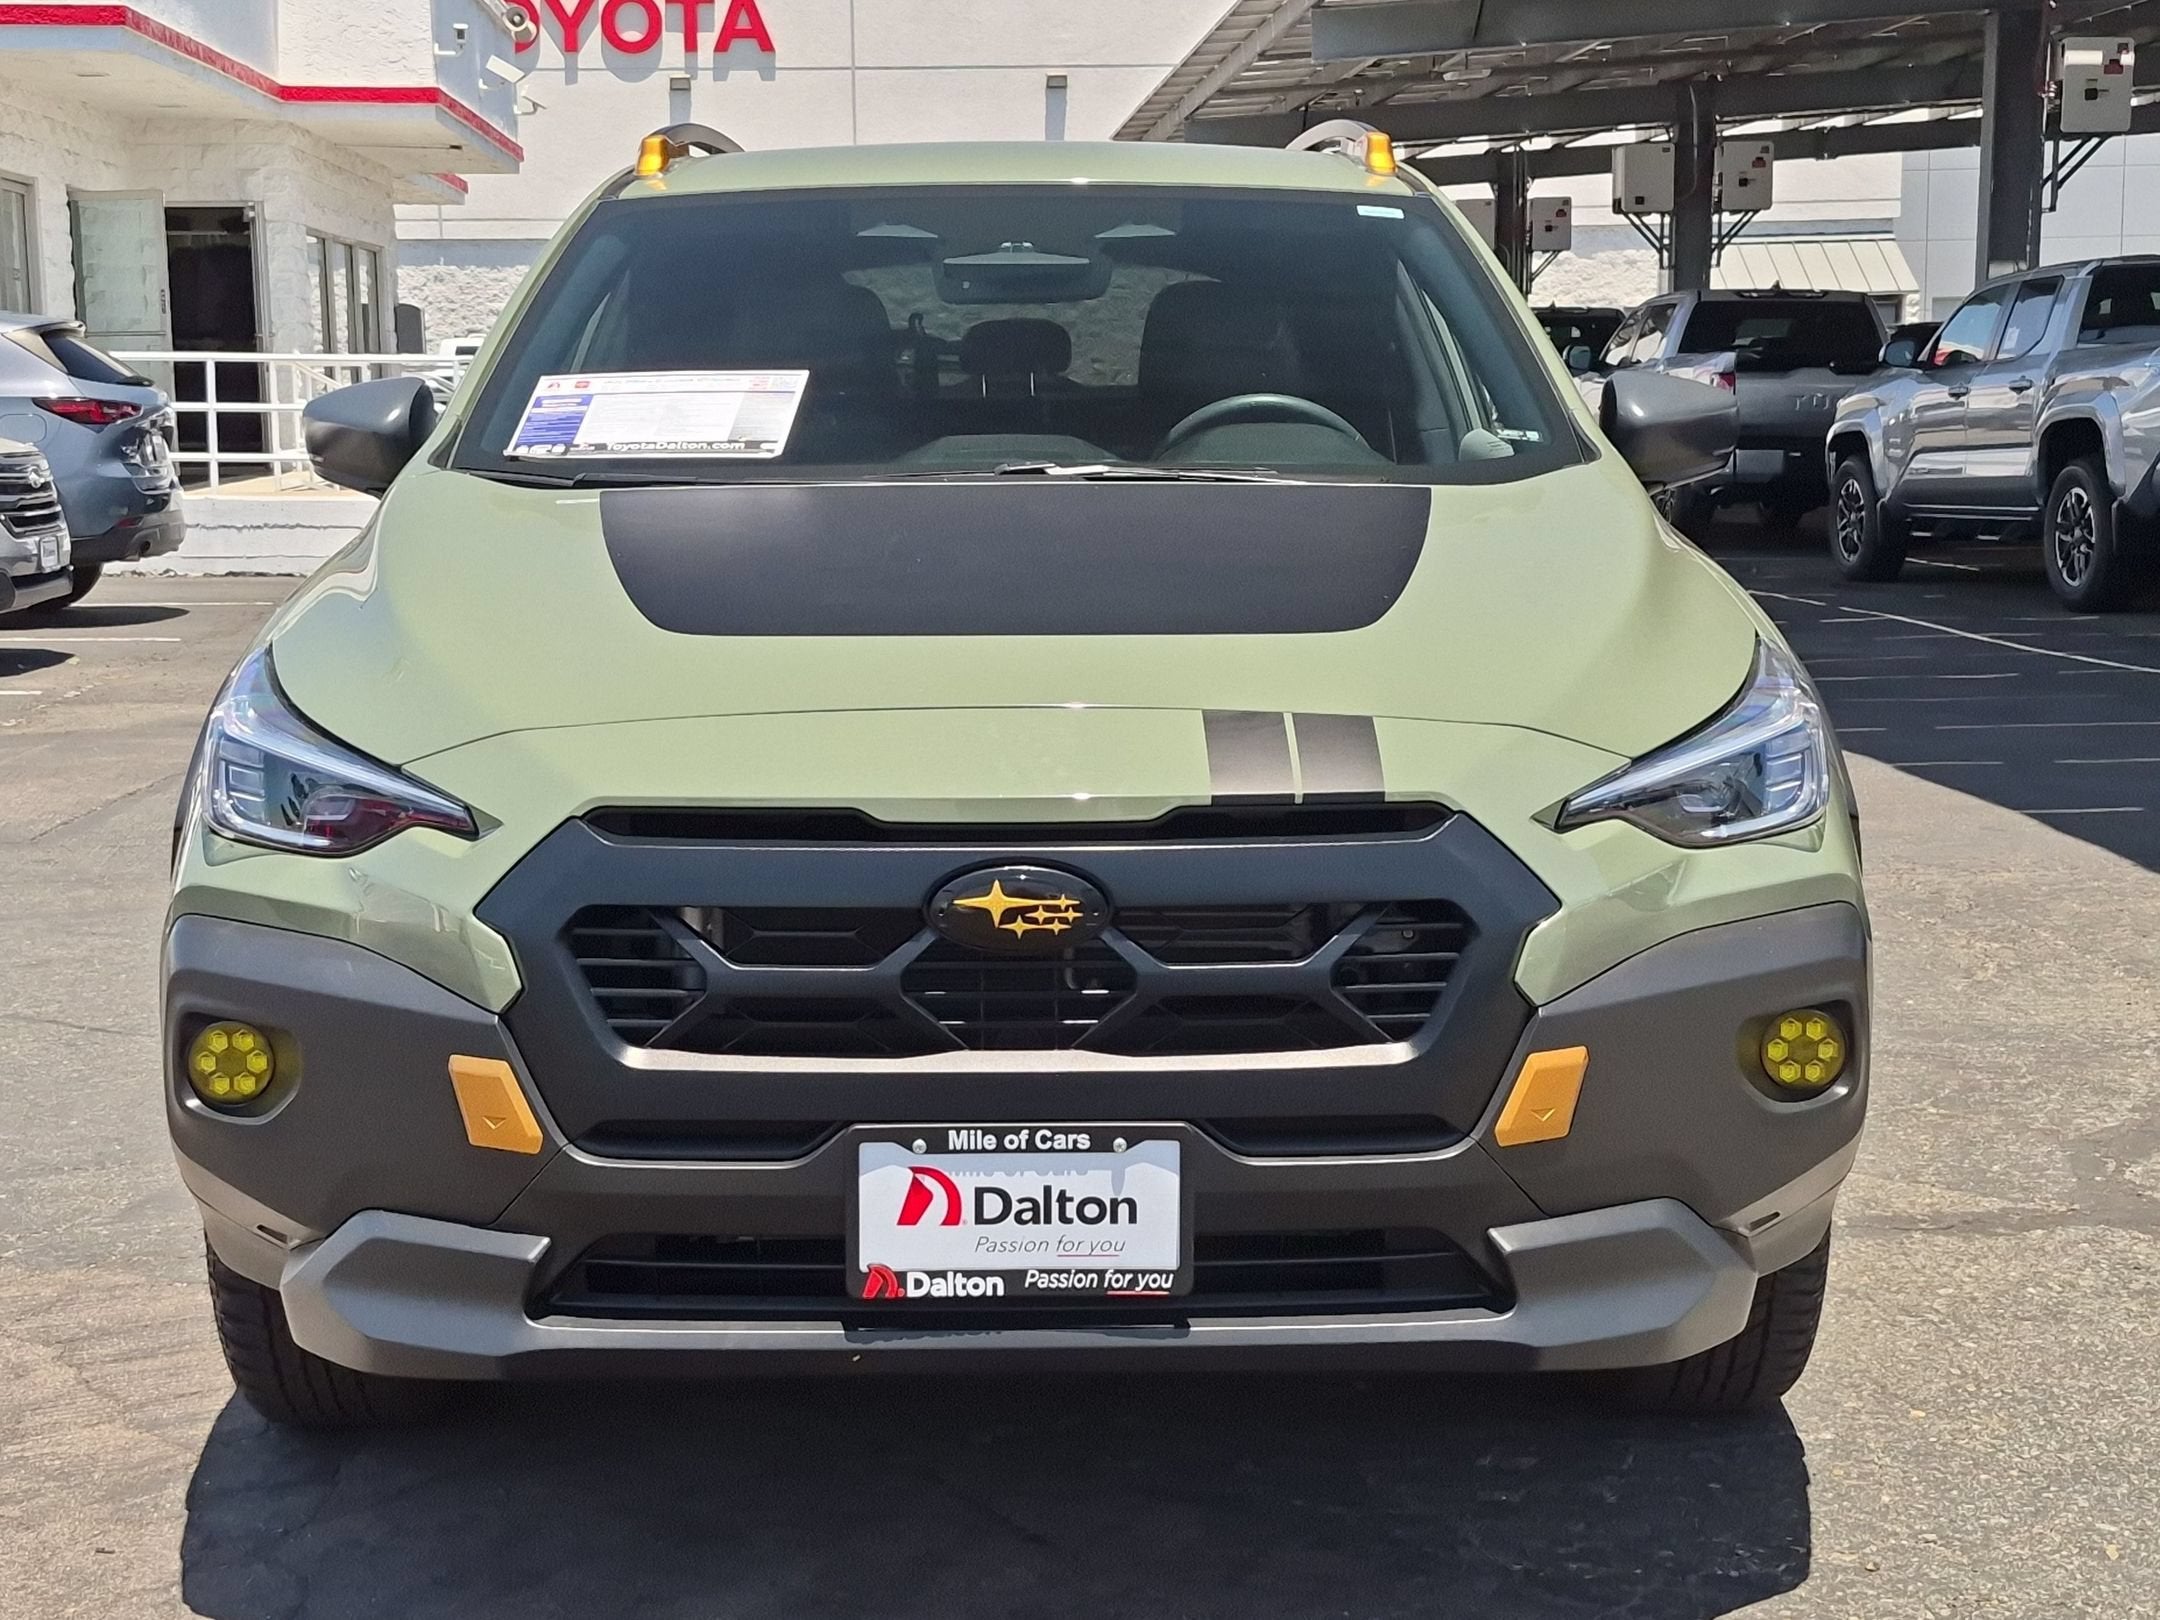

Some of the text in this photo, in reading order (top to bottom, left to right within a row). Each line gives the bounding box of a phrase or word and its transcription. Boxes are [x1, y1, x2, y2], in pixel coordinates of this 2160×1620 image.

[948, 1128, 1091, 1150] Mile of Cars
[975, 1184, 1138, 1225] Dalton
[975, 1234, 1126, 1255] Passion for you
[906, 1271, 1005, 1297] Dalton
[1024, 1269, 1174, 1292] Passion for you
